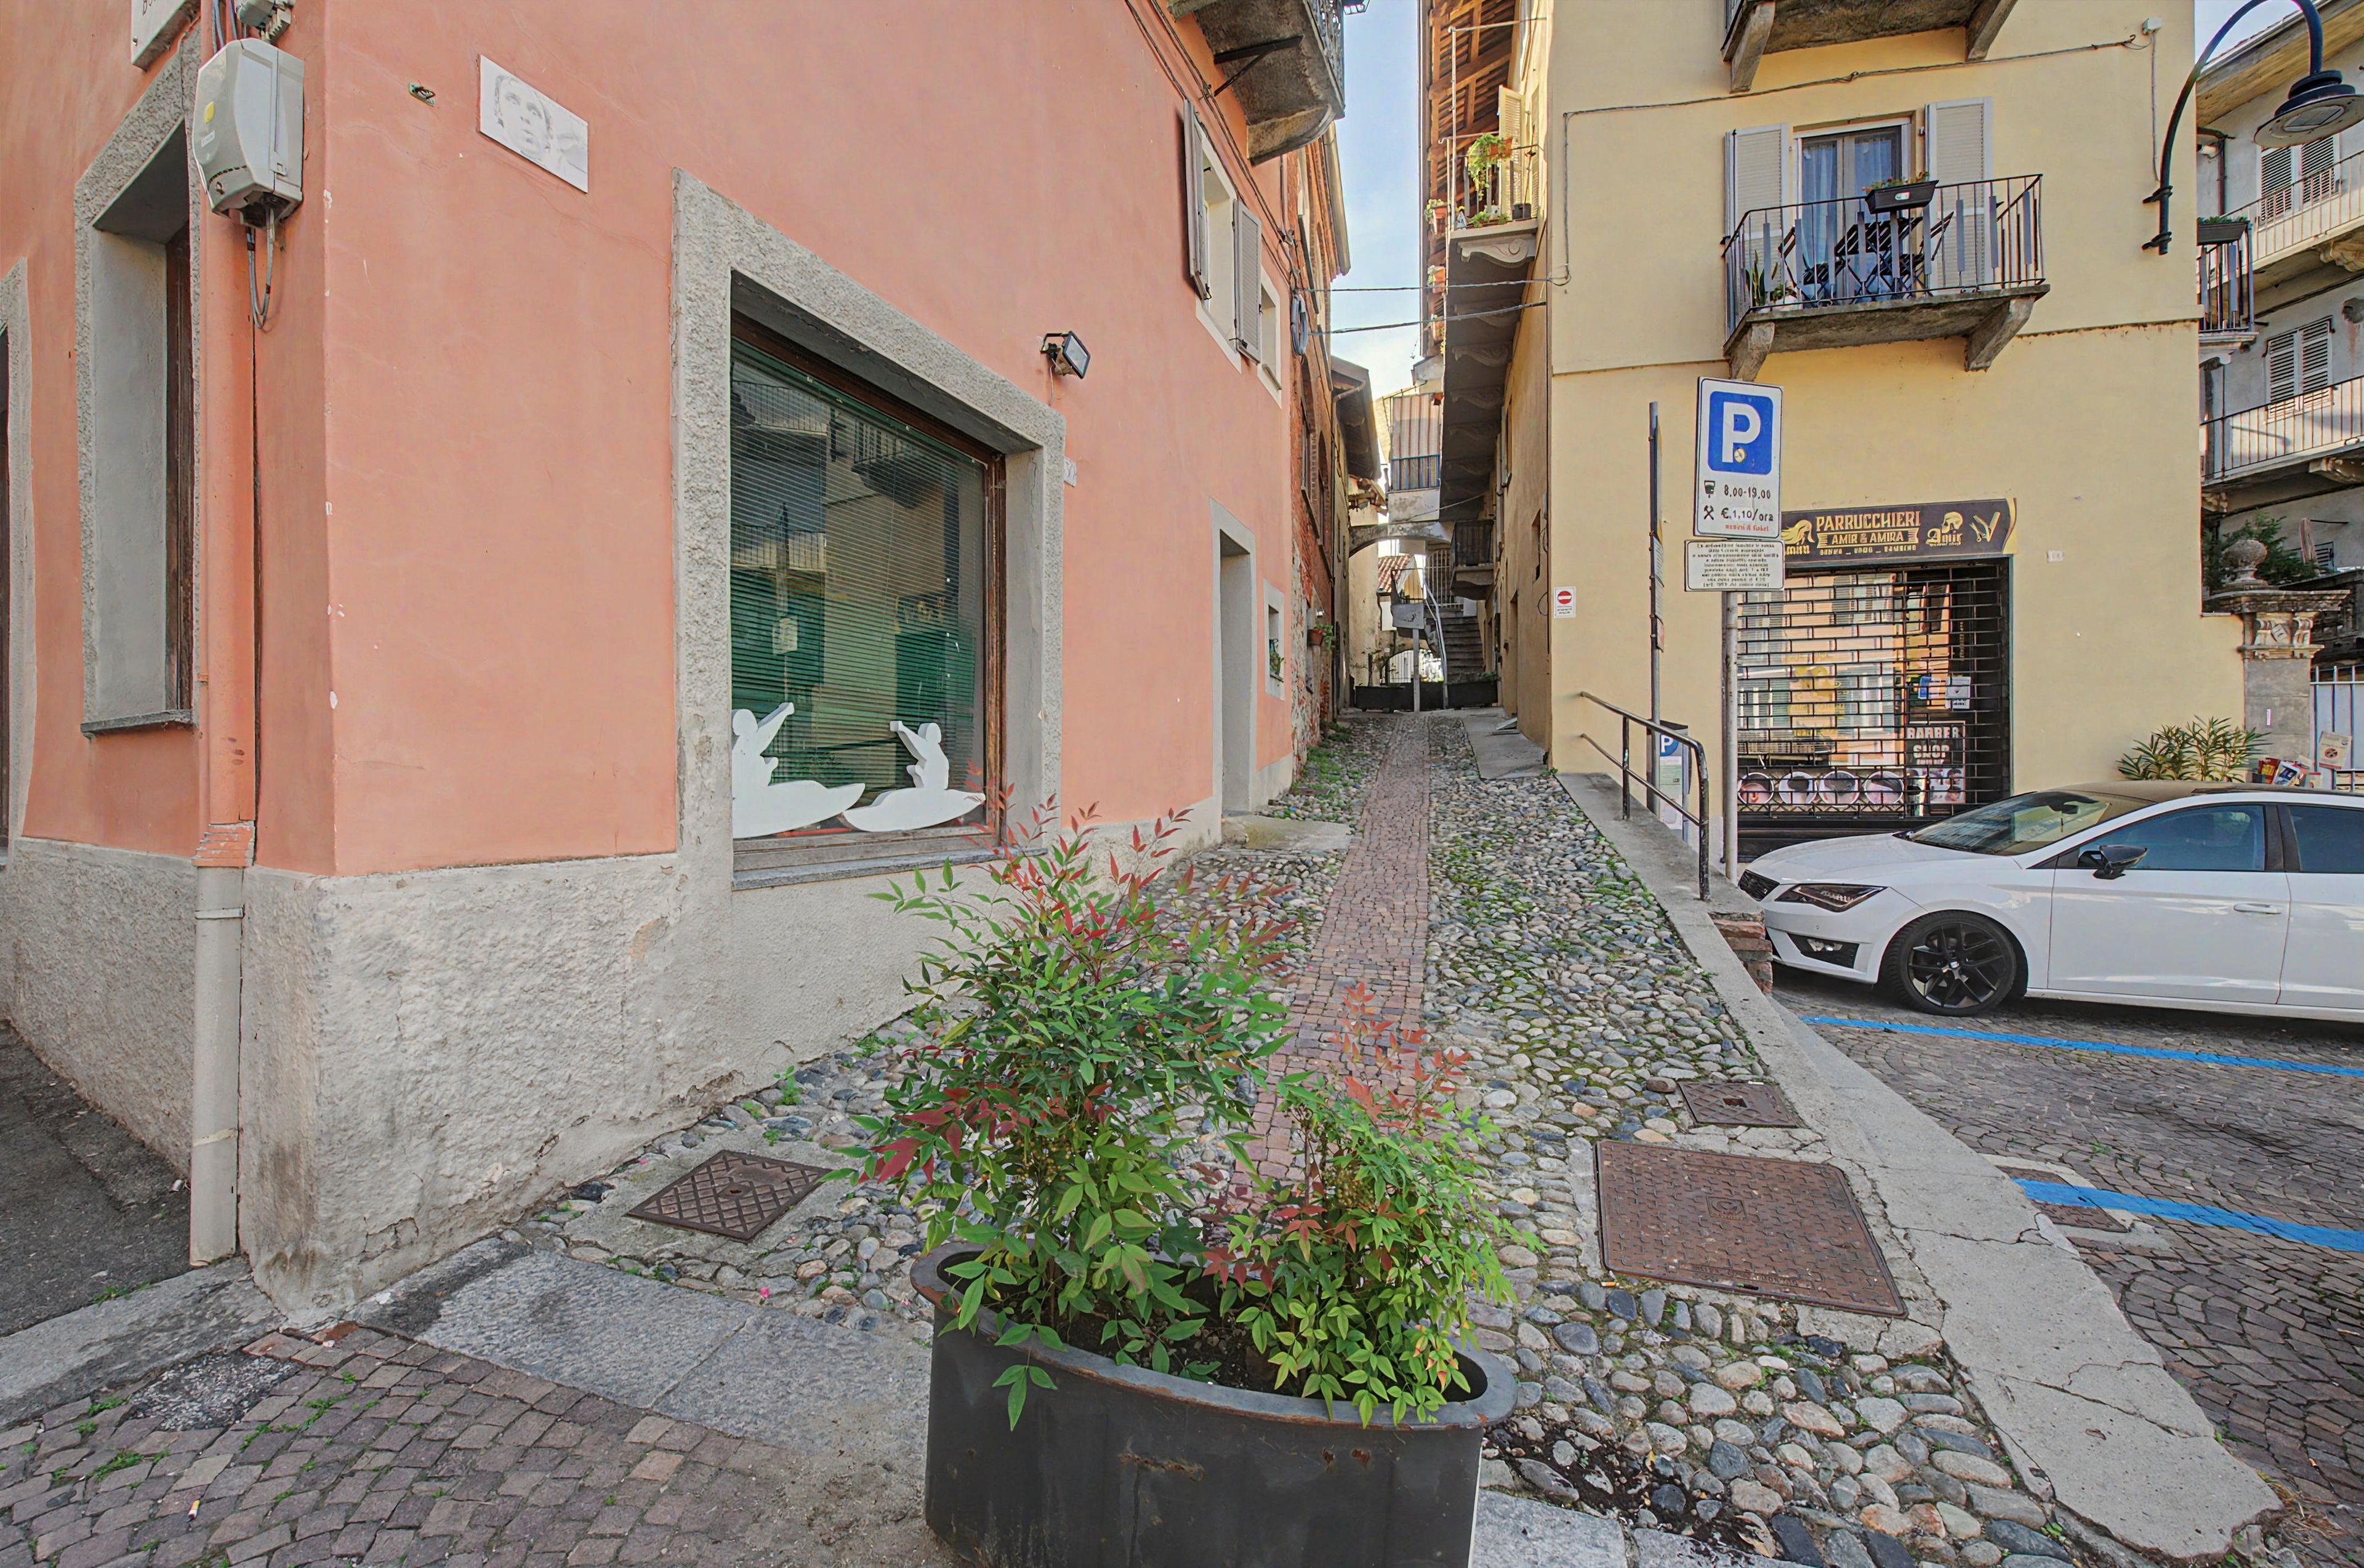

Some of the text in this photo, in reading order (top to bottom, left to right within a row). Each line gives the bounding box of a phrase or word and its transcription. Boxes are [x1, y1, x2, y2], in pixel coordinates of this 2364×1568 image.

[1722, 401, 1761, 463] P
[1815, 511, 1921, 531] PARRUCCHIERI
[1831, 531, 1904, 545] AMIR & AMIRA
[1926, 528, 1963, 544] Amir
[1906, 727, 1960, 739] BARBER
[1661, 734, 1673, 753] P
